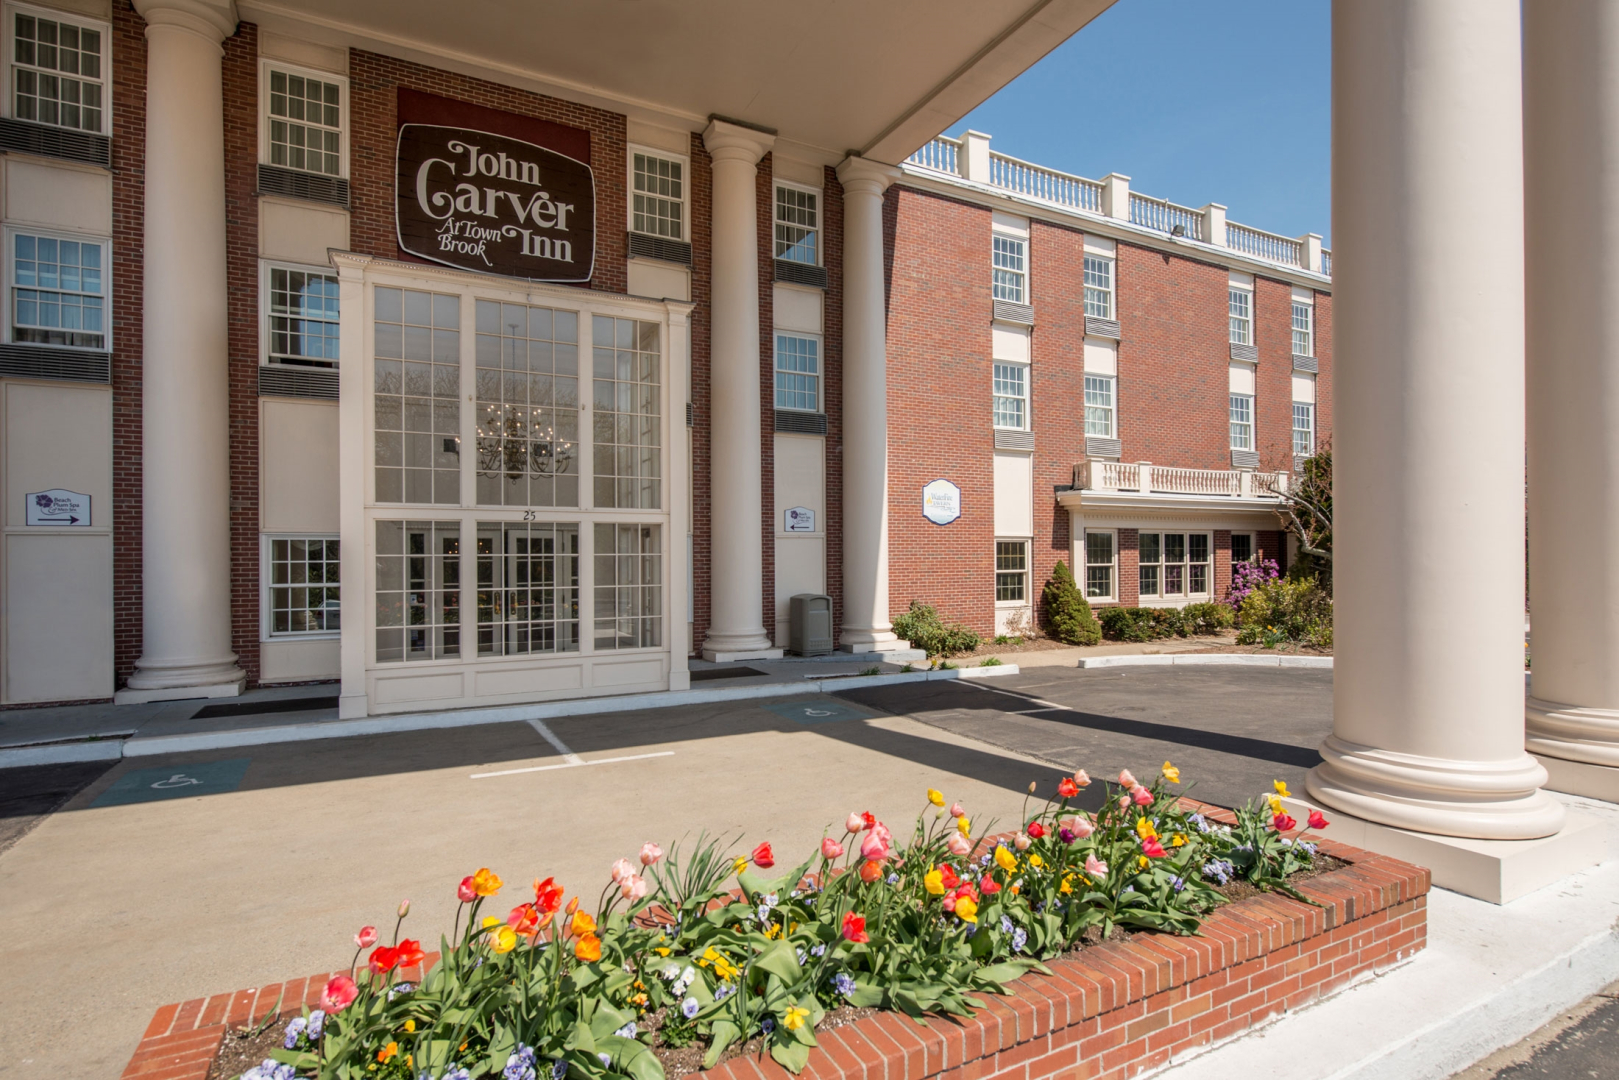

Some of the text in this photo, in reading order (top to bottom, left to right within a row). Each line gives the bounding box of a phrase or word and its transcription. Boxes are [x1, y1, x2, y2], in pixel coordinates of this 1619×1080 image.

[447, 140, 542, 187] John
[416, 158, 574, 231] Carver
[435, 217, 502, 242] At Town
[501, 224, 574, 263] Inn
[437, 232, 493, 266] Brook
[523, 510, 536, 521] 25
